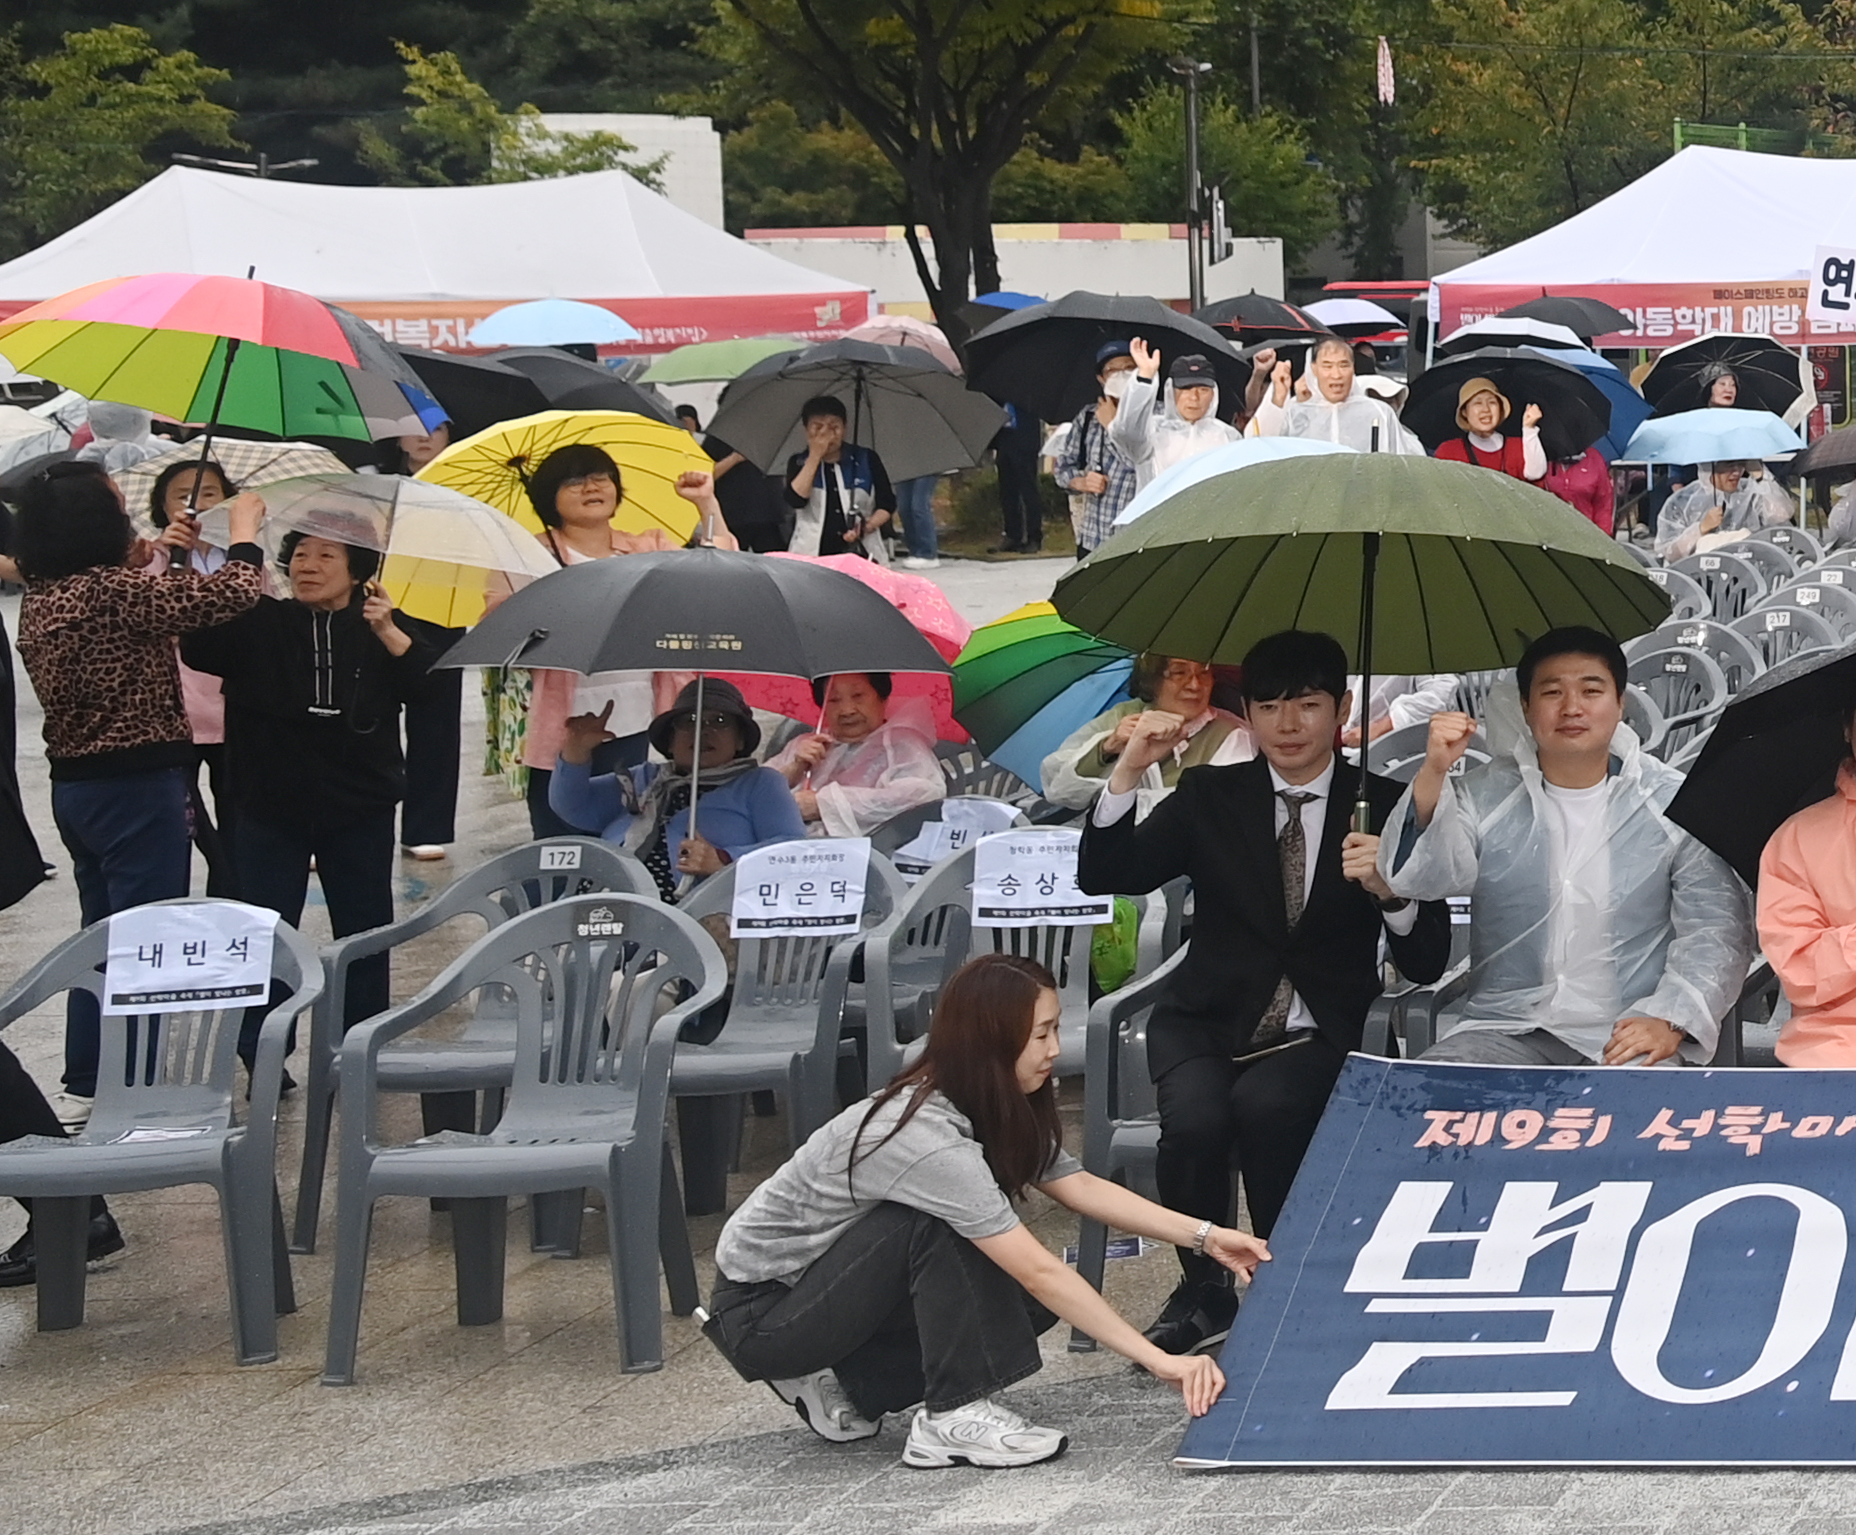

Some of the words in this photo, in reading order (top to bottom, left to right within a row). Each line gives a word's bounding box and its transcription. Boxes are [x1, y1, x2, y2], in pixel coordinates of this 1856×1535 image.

[1742, 303, 1801, 336] 예방
[548, 851, 576, 865] 172
[577, 922, 624, 936] 청년렌탈
[1415, 1108, 1613, 1152] 제9회
